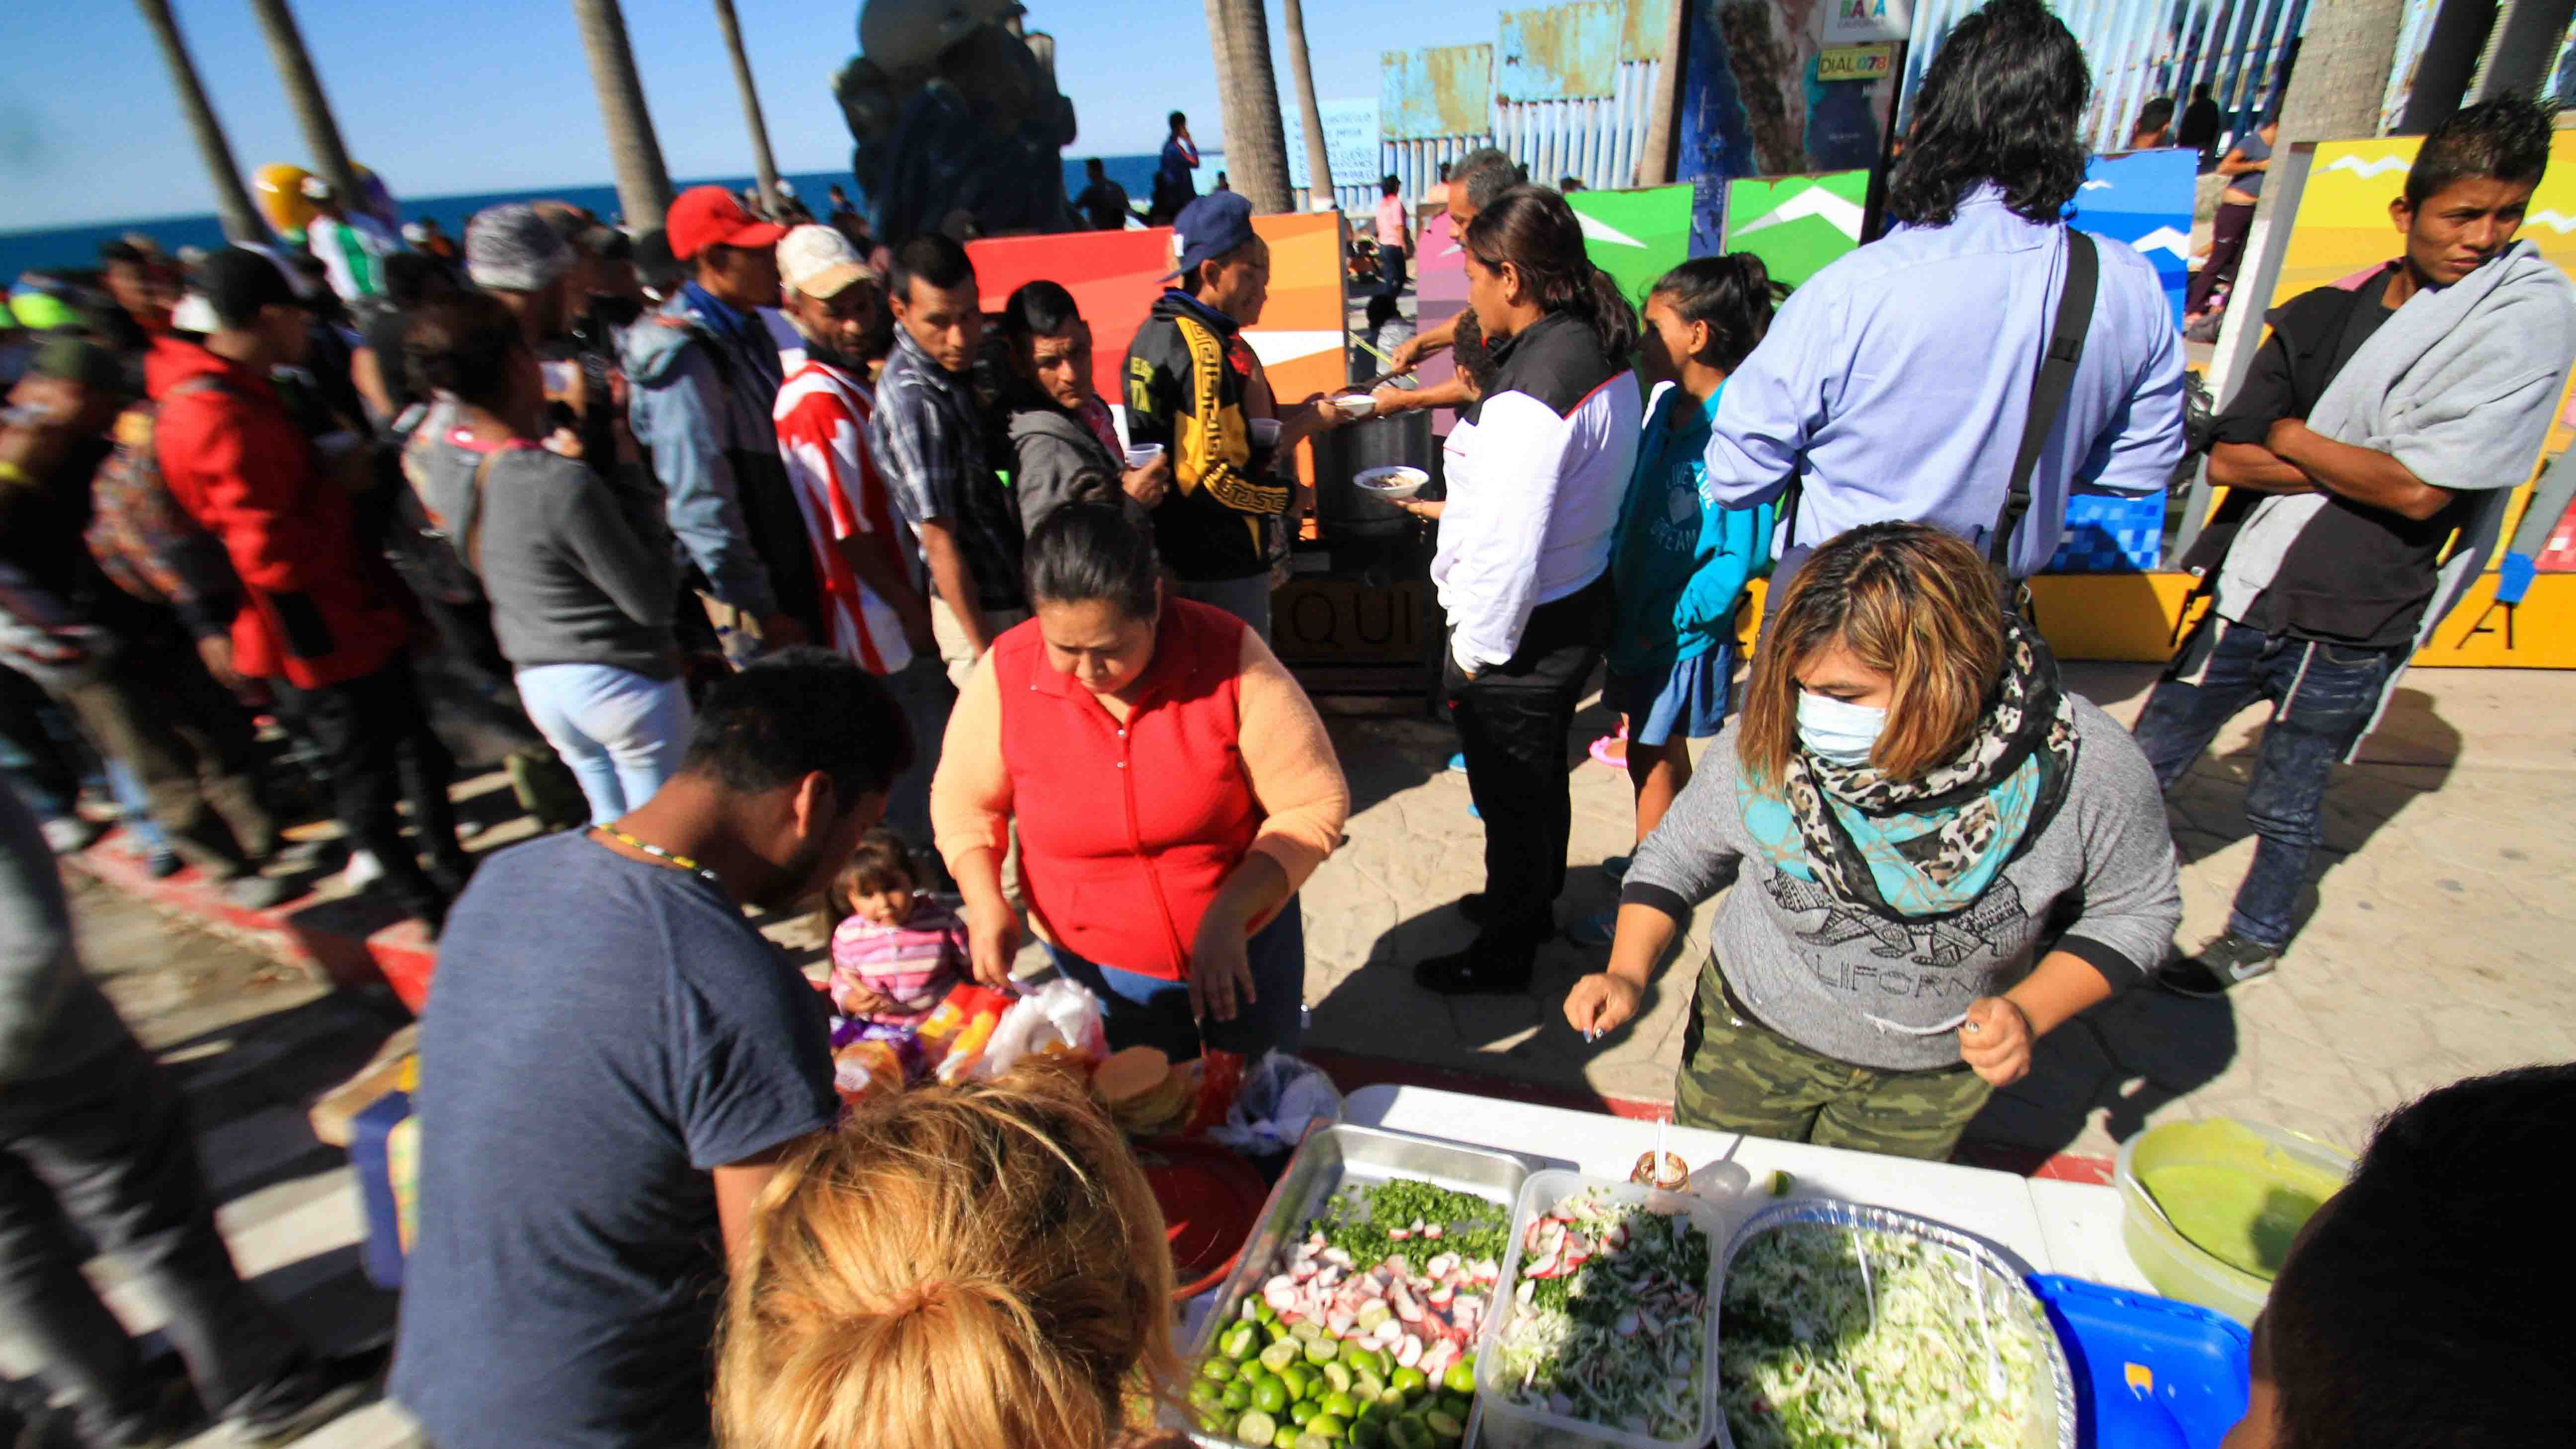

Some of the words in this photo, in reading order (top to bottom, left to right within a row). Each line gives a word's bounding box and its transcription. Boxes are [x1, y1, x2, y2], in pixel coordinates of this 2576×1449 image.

[1820, 57, 1855, 73] DIAL
[1857, 56, 1888, 71] 078
[1274, 591, 1411, 649] QUI
[1805, 952, 1973, 998] LIFORN
